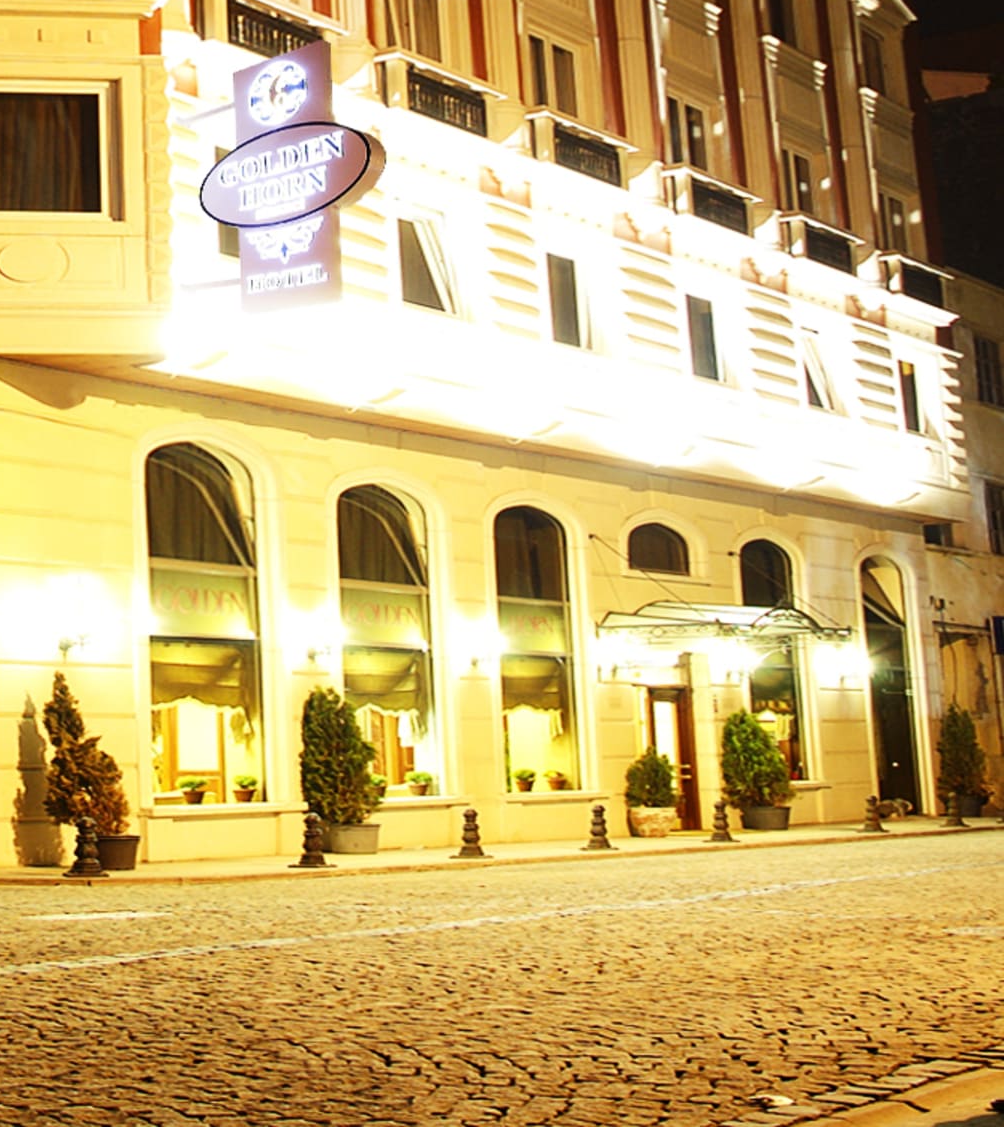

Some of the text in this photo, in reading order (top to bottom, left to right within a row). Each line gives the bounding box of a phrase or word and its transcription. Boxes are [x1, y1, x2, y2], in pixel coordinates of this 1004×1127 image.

[219, 131, 344, 187] GOLDEN
[239, 166, 325, 210] HORN
[154, 584, 246, 615] GOLDEN
[344, 601, 422, 626] GOLDEN
